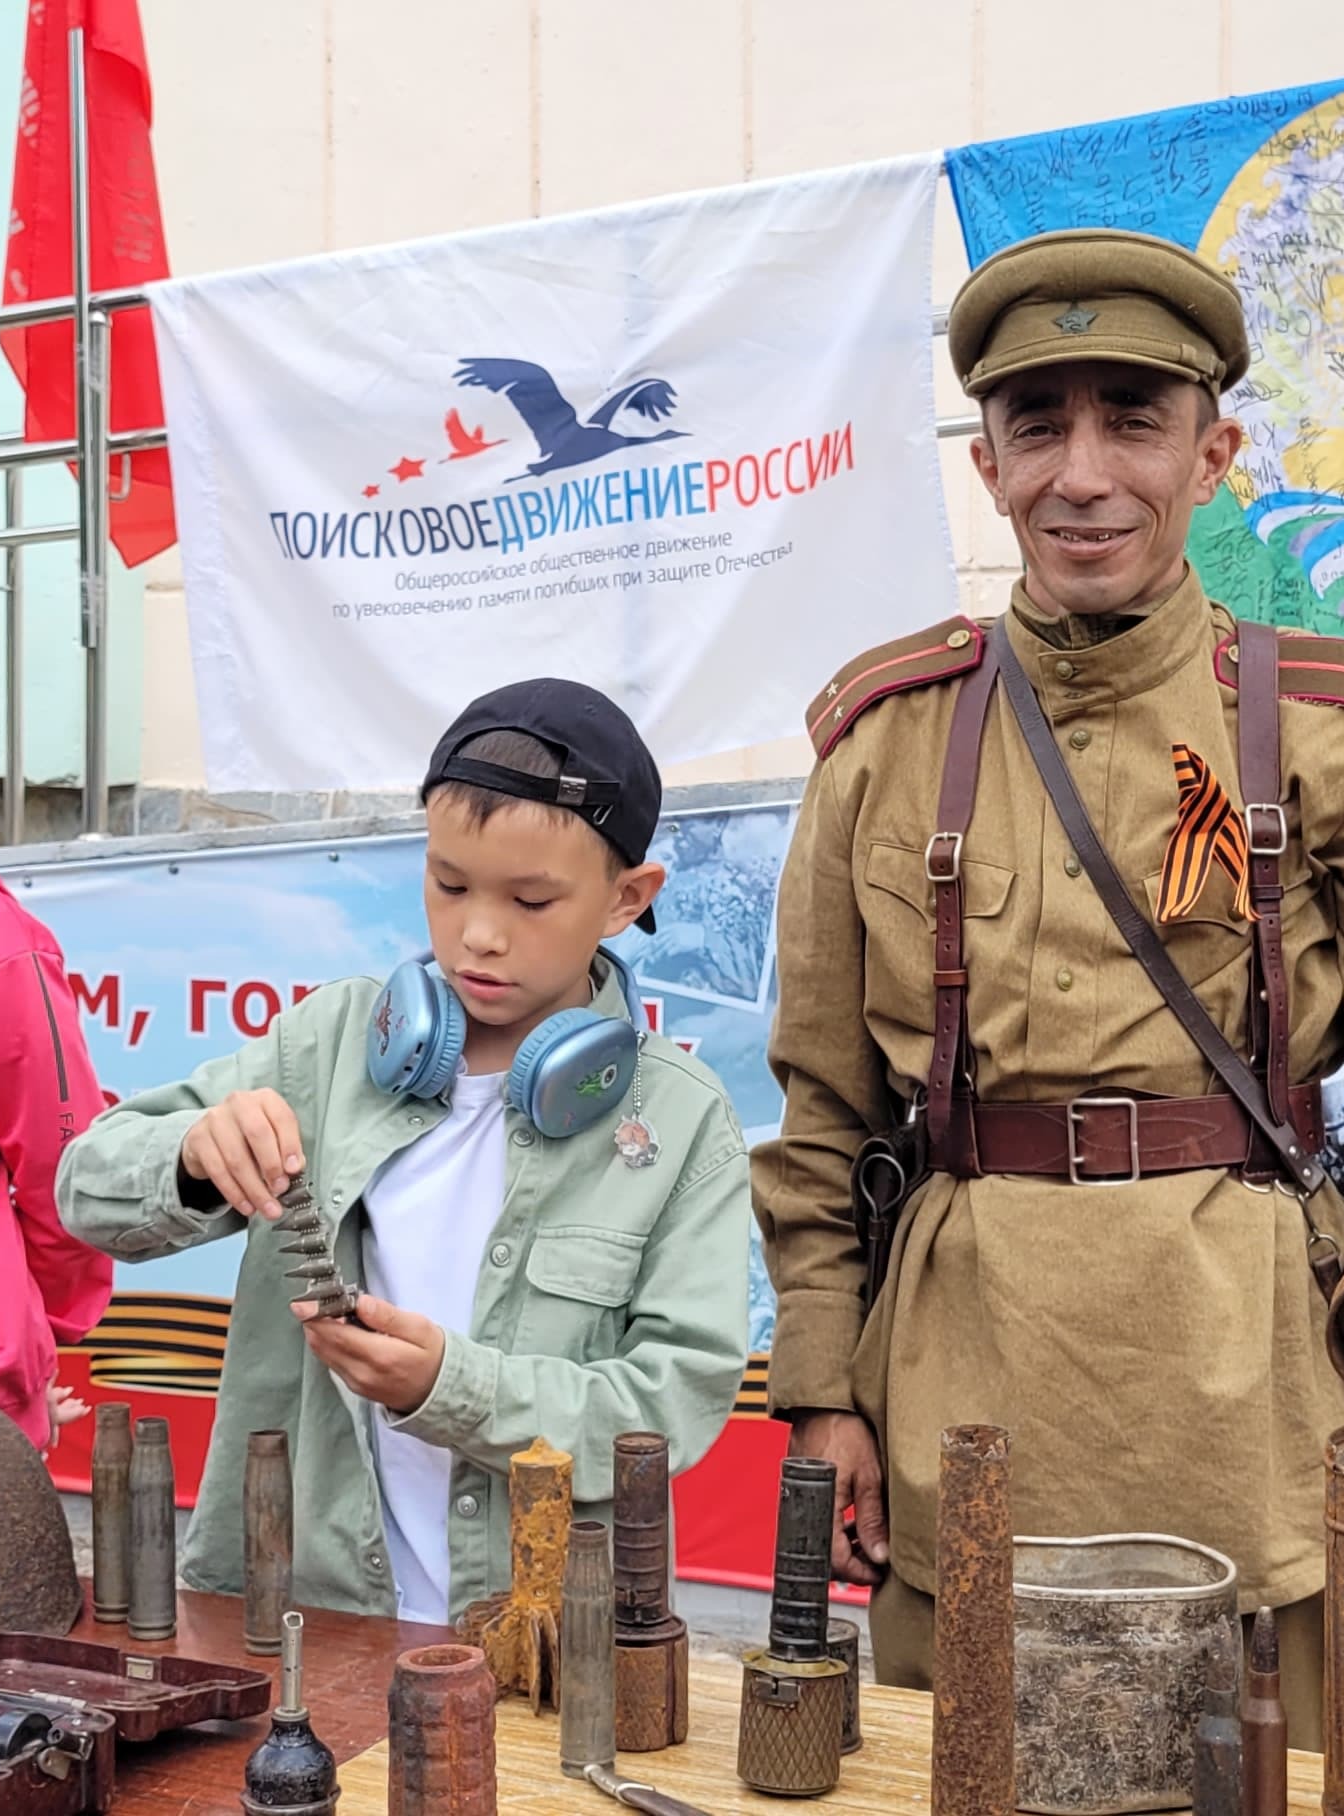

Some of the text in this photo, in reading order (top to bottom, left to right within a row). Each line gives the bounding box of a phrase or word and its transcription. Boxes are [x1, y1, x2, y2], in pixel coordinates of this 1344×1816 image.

[332, 601, 350, 618] по
[354, 596, 473, 621] увековечению
[477, 587, 531, 609] памяти
[534, 576, 610, 601] погибших
[612, 569, 643, 592] при
[647, 559, 712, 584] защите
[394, 530, 733, 591] Общероссийское общественное движение
